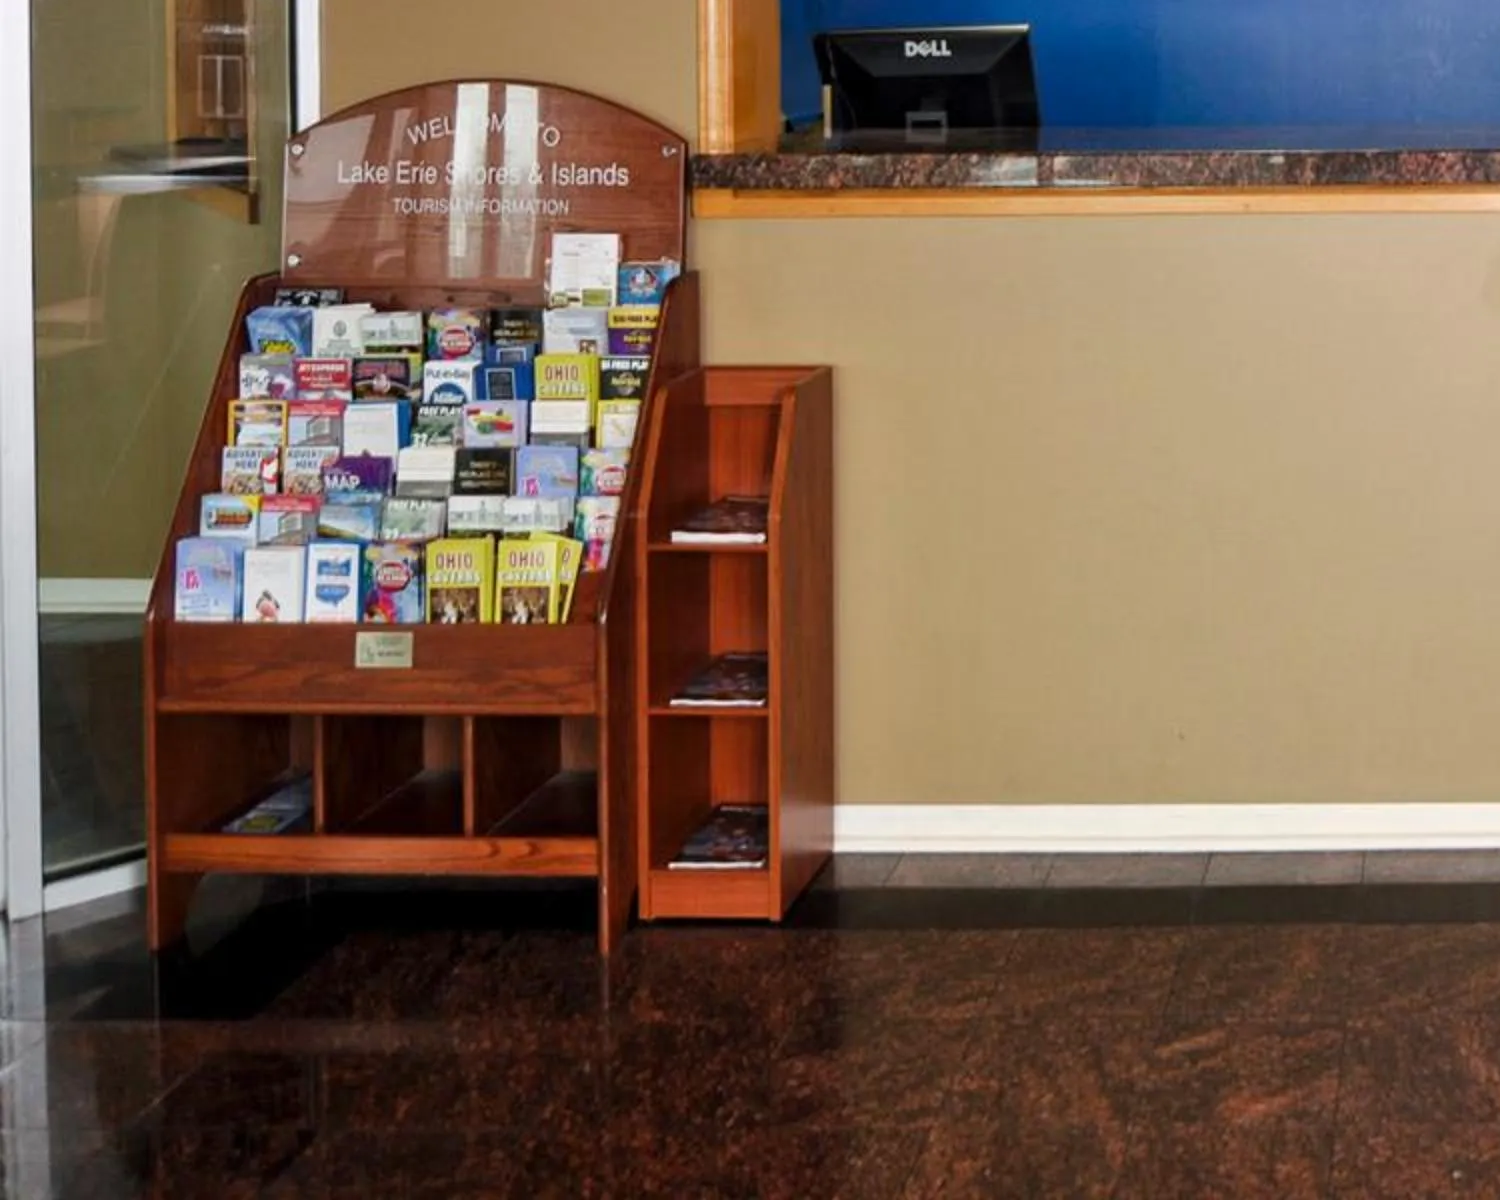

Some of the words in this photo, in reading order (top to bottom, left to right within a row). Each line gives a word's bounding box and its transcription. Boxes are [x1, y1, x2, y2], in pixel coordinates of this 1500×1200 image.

[903, 39, 953, 59] DELL
[336, 159, 389, 185] Lake
[395, 159, 438, 185] Erie
[551, 161, 630, 187] Islands
[544, 364, 580, 382] OHIO
[435, 551, 474, 570] OHIO
[508, 550, 546, 568] OHIO
